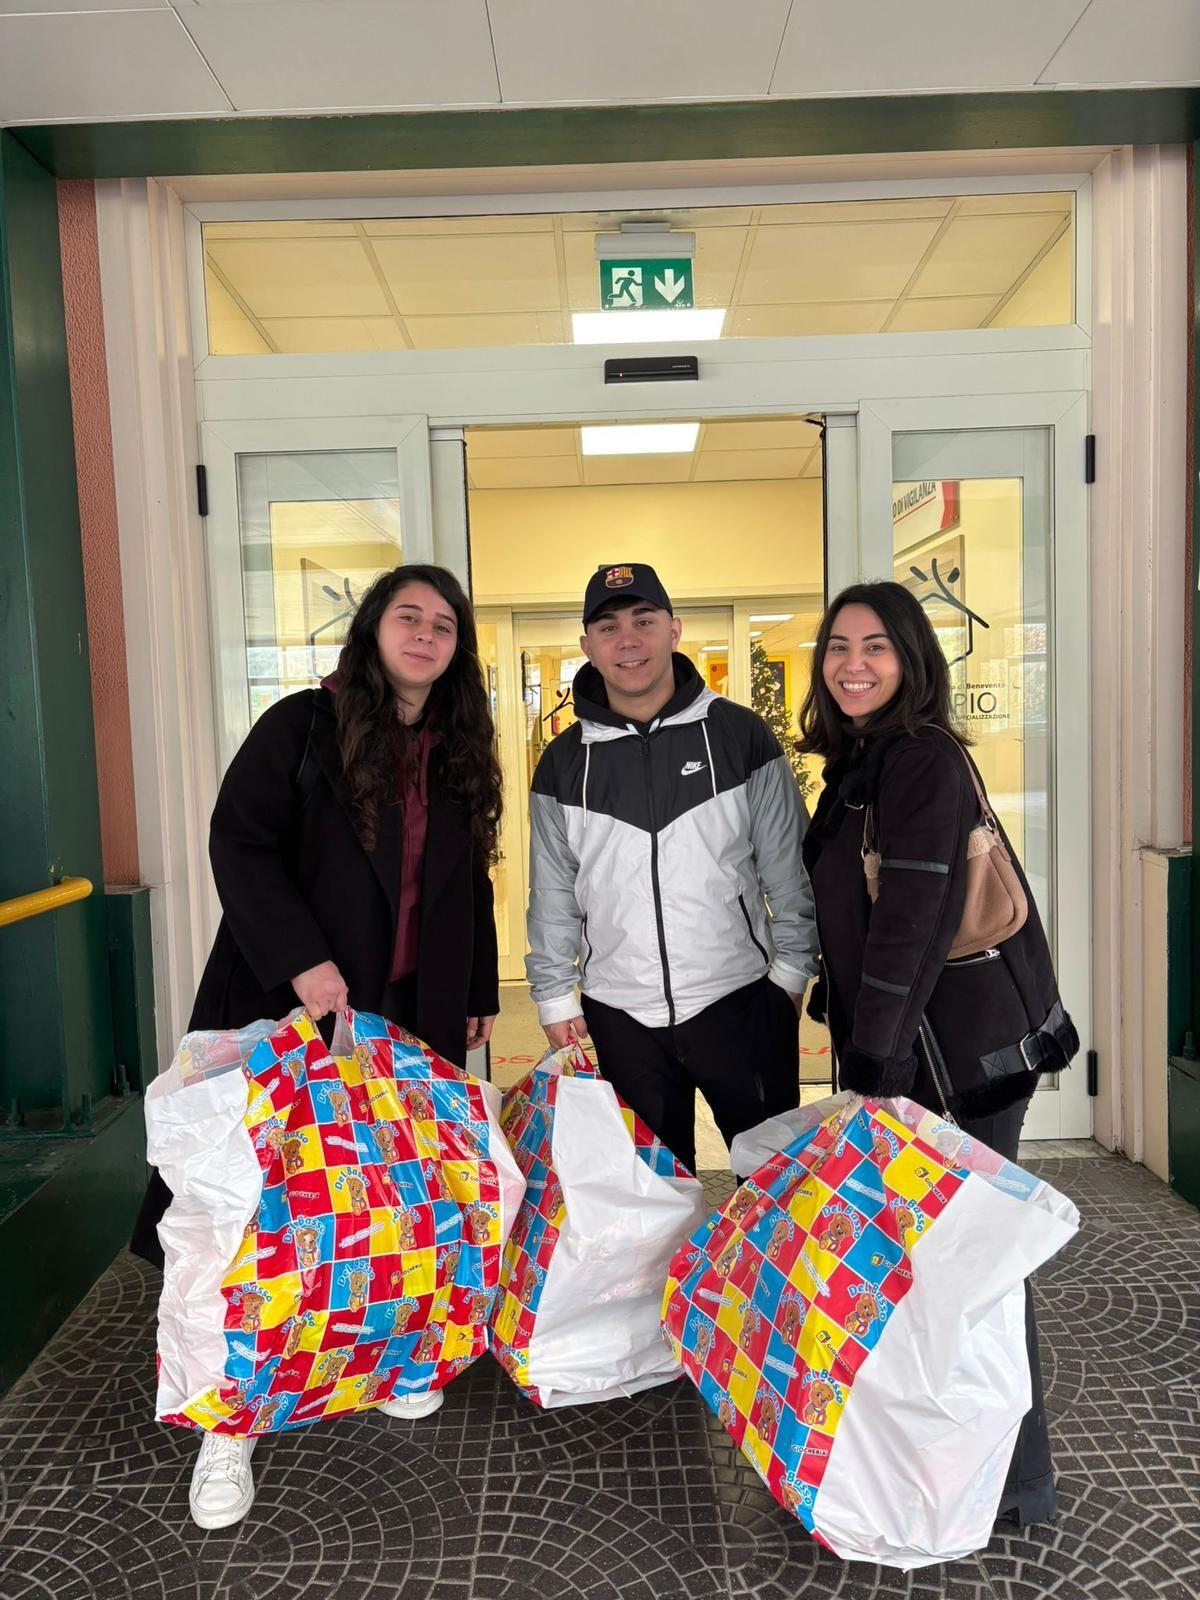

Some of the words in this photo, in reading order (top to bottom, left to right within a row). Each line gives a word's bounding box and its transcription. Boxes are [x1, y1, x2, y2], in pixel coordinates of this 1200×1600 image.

[898, 497, 904, 515] DI
[904, 482, 936, 511] VIGILANZA
[954, 692, 997, 713] PIO
[684, 761, 703, 769] NIKE
[317, 1084, 333, 1104] Del
[284, 1132, 309, 1143] Basso
[883, 1128, 899, 1159] Basso
[334, 1171, 347, 1190] Del
[347, 1166, 370, 1187] Basso
[425, 1161, 434, 1179] Del
[925, 1178, 947, 1203] GIOCHERIA
[474, 1200, 498, 1218] Basso
[821, 1203, 842, 1217] Del
[845, 1205, 861, 1239] Basso
[907, 1199, 924, 1231] Basso
[282, 1222, 297, 1243] Del
[298, 1216, 326, 1234] Basso
[338, 1264, 353, 1286] Del
[242, 1283, 272, 1302] Basso
[848, 1282, 869, 1297] Del
[872, 1283, 887, 1320] Basso
[794, 1290, 806, 1326] Basso
[820, 1369, 844, 1404] Basso
[769, 1387, 780, 1424] Basso
[792, 1444, 828, 1457] GIOCHERIA
[787, 1470, 812, 1506] Basso
